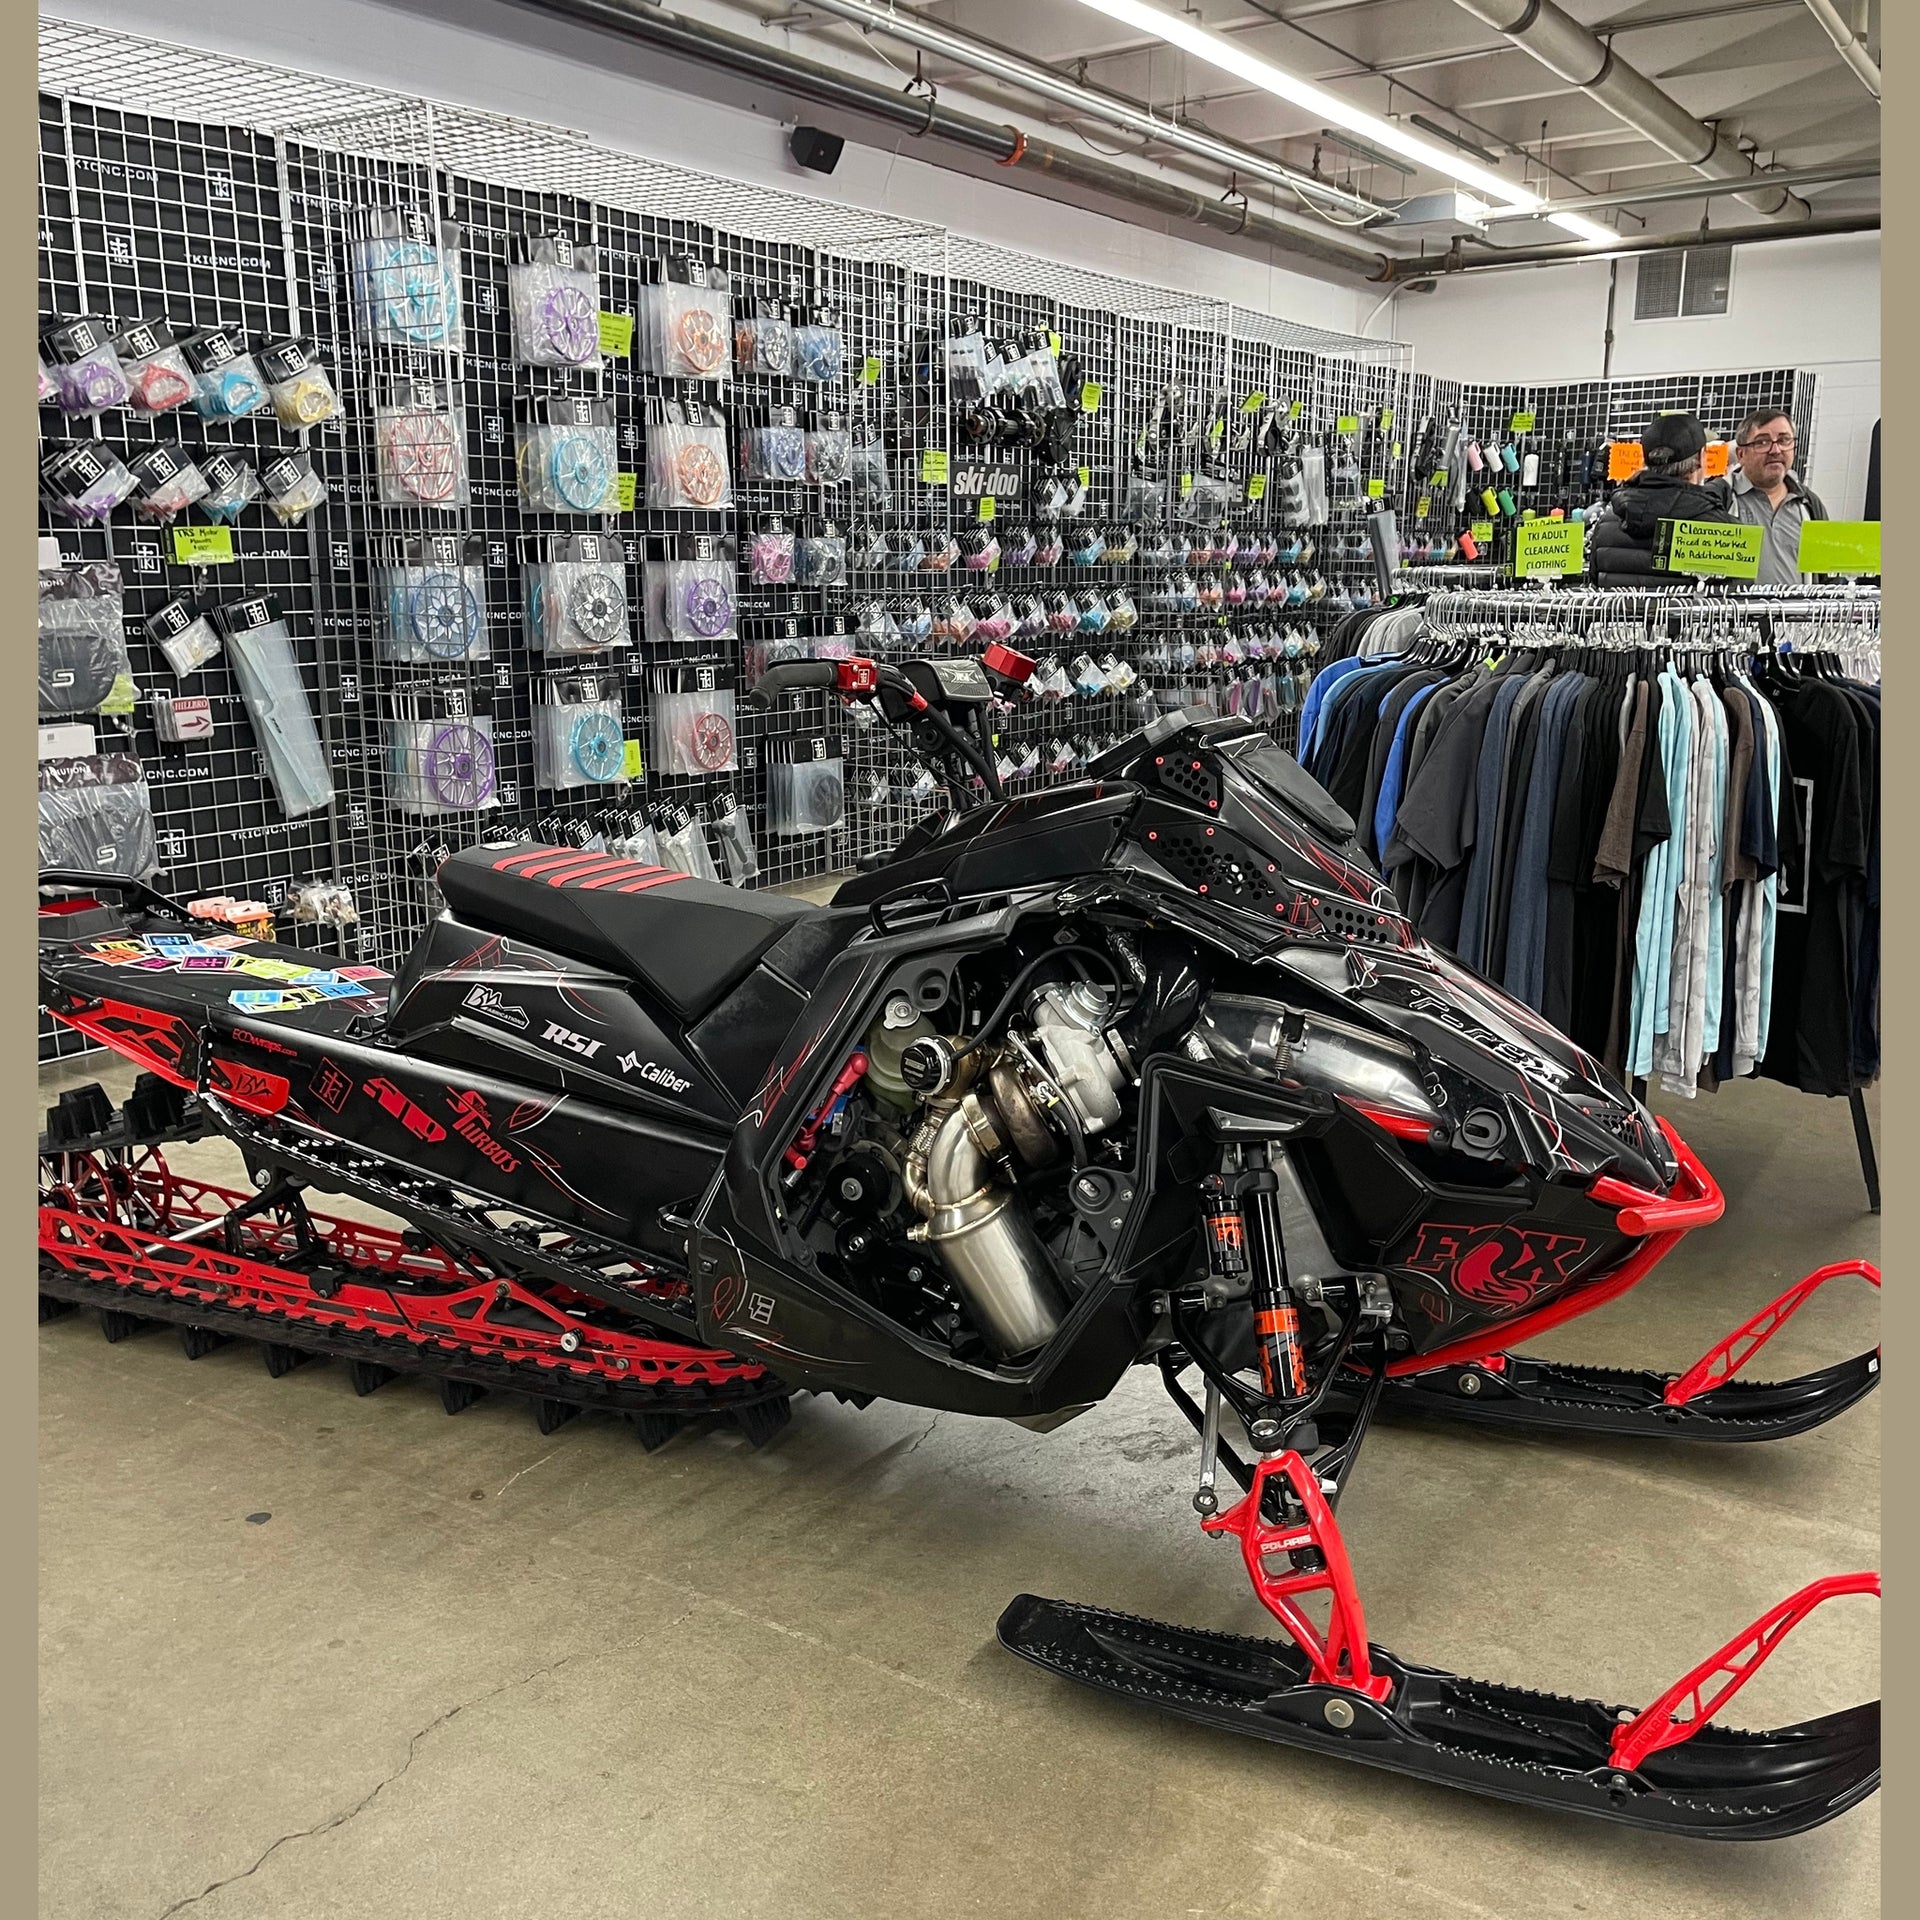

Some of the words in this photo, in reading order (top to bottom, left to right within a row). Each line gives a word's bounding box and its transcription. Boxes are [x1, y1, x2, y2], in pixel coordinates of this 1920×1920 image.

[74, 159, 159, 182] KICNC.COM
[1528, 532, 1539, 542] TKI
[1541, 529, 1569, 540] ADULT
[1524, 544, 1570, 556] CLEARANCE
[1675, 536, 1699, 547] Priced
[1701, 539, 1712, 547] as
[1714, 540, 1747, 550] Marked
[1674, 549, 1685, 560] No
[1689, 549, 1735, 561] Additional
[1526, 559, 1567, 570] CLOTHING
[146, 766, 209, 780] CNC.COM
[539, 1019, 608, 1060] RSI
[641, 1061, 692, 1094] Caliber
[1407, 1222, 1587, 1294] FOX
[1260, 1533, 1312, 1553] POLARIS
